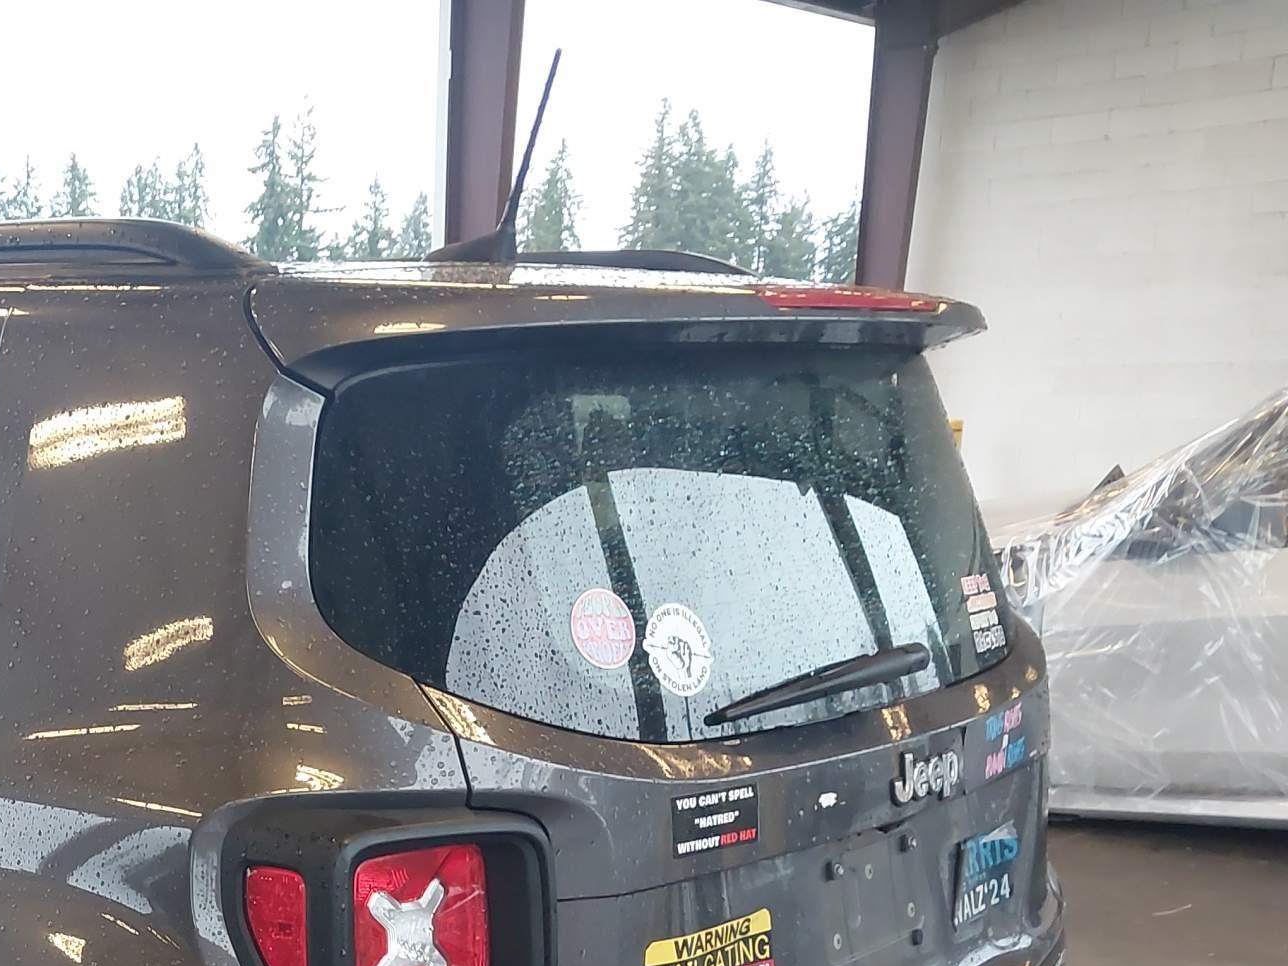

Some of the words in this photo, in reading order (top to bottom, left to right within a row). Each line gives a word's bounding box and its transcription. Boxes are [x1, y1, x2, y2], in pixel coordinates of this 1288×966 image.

[649, 622, 657, 638] NO
[656, 608, 671, 622] ONE
[672, 607, 680, 616] IS
[681, 609, 707, 648] ILLEGAL
[652, 656, 662, 673] ON
[662, 672, 692, 692] STOLEN
[692, 666, 707, 688] LAND
[894, 751, 959, 803] Jeep
[676, 797, 697, 811] YOU
[698, 791, 726, 807] CAN'T
[728, 786, 754, 802] SPELL
[694, 810, 740, 829] "HATRED"
[677, 836, 720, 855] WITHOUT
[720, 832, 738, 846] RED
[739, 828, 757, 841] HAT
[674, 917, 751, 959] WARNING
